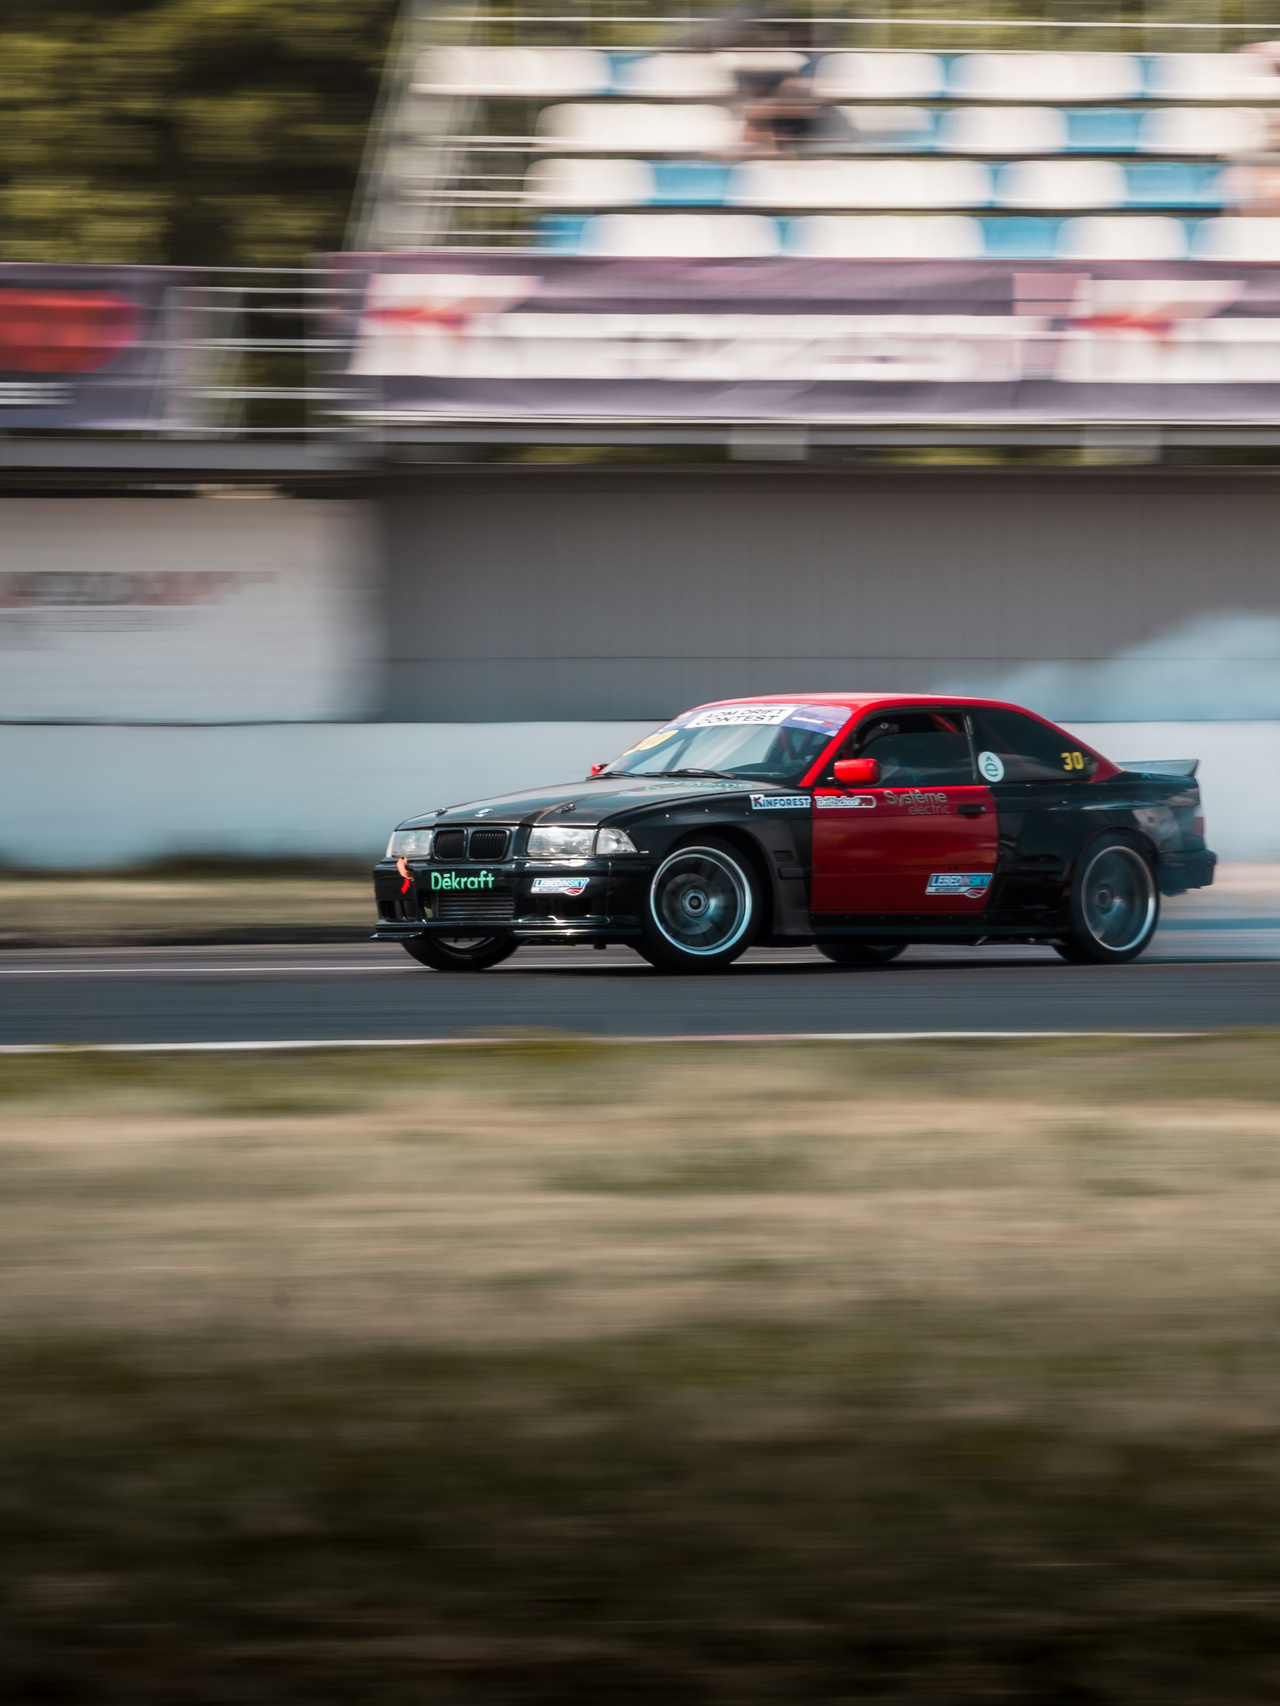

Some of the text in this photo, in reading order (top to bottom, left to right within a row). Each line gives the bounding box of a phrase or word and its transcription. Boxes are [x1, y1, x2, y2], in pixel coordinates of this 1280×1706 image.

[696, 715, 780, 726] CONTEST
[1061, 751, 1085, 771] 30
[753, 796, 810, 807] KINFOREST
[883, 789, 948, 807] Système
[908, 804, 951, 815] electric
